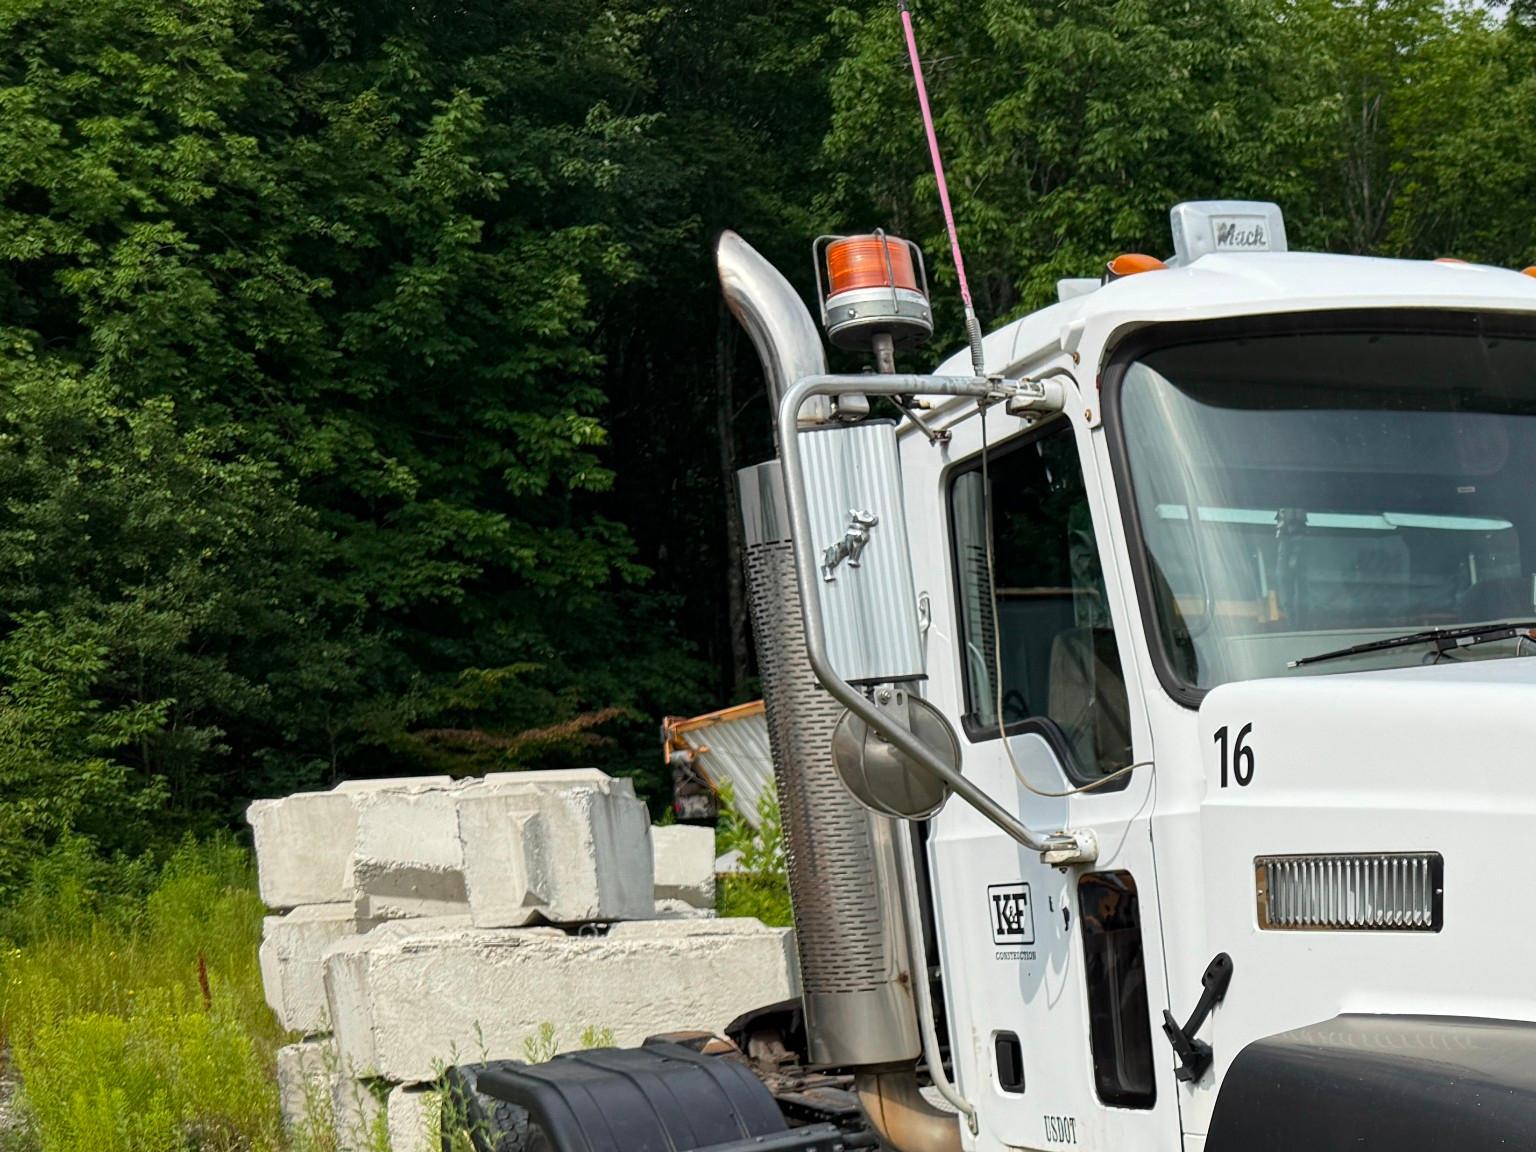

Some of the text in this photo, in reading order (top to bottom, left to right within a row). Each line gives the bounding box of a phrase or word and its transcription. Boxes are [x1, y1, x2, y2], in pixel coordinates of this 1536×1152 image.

[1217, 222, 1267, 246] Mack
[1213, 721, 1255, 789] 16
[1043, 1114, 1077, 1145] USDOT
